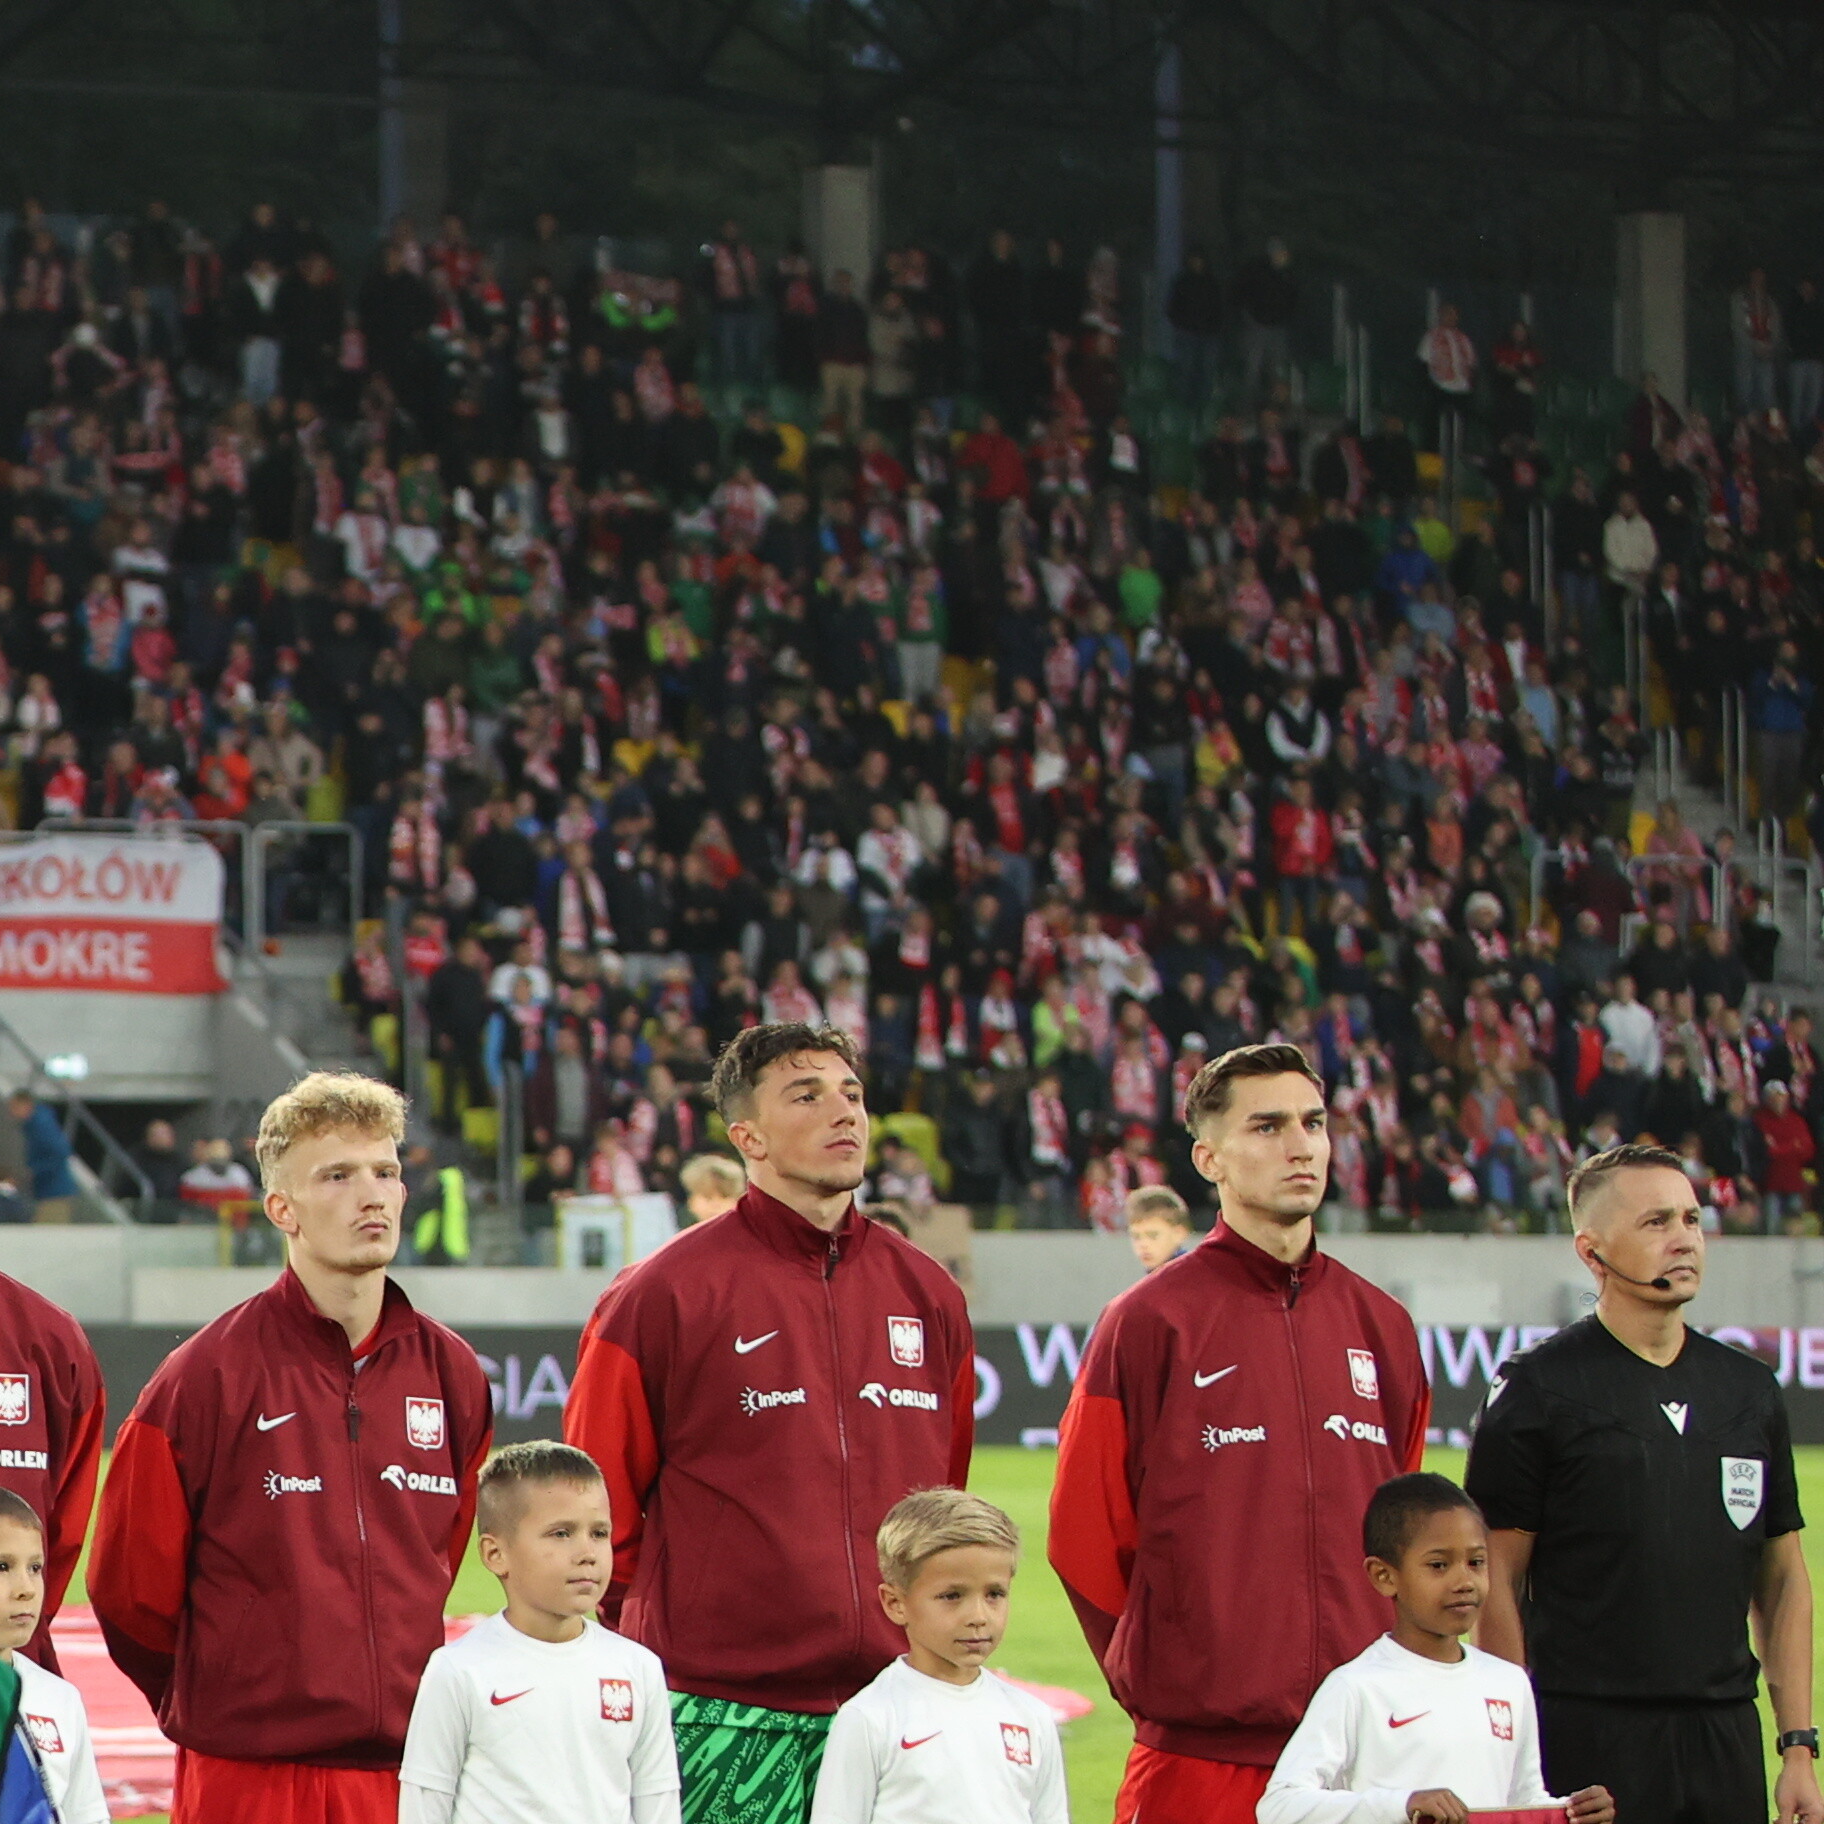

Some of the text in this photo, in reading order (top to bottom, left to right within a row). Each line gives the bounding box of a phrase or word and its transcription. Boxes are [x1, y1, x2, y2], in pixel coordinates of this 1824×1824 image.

[758, 1387, 807, 1408] InPost
[889, 1388, 938, 1411] ORLEN
[1219, 1426, 1267, 1443] InPost
[280, 1475, 322, 1492] InPost
